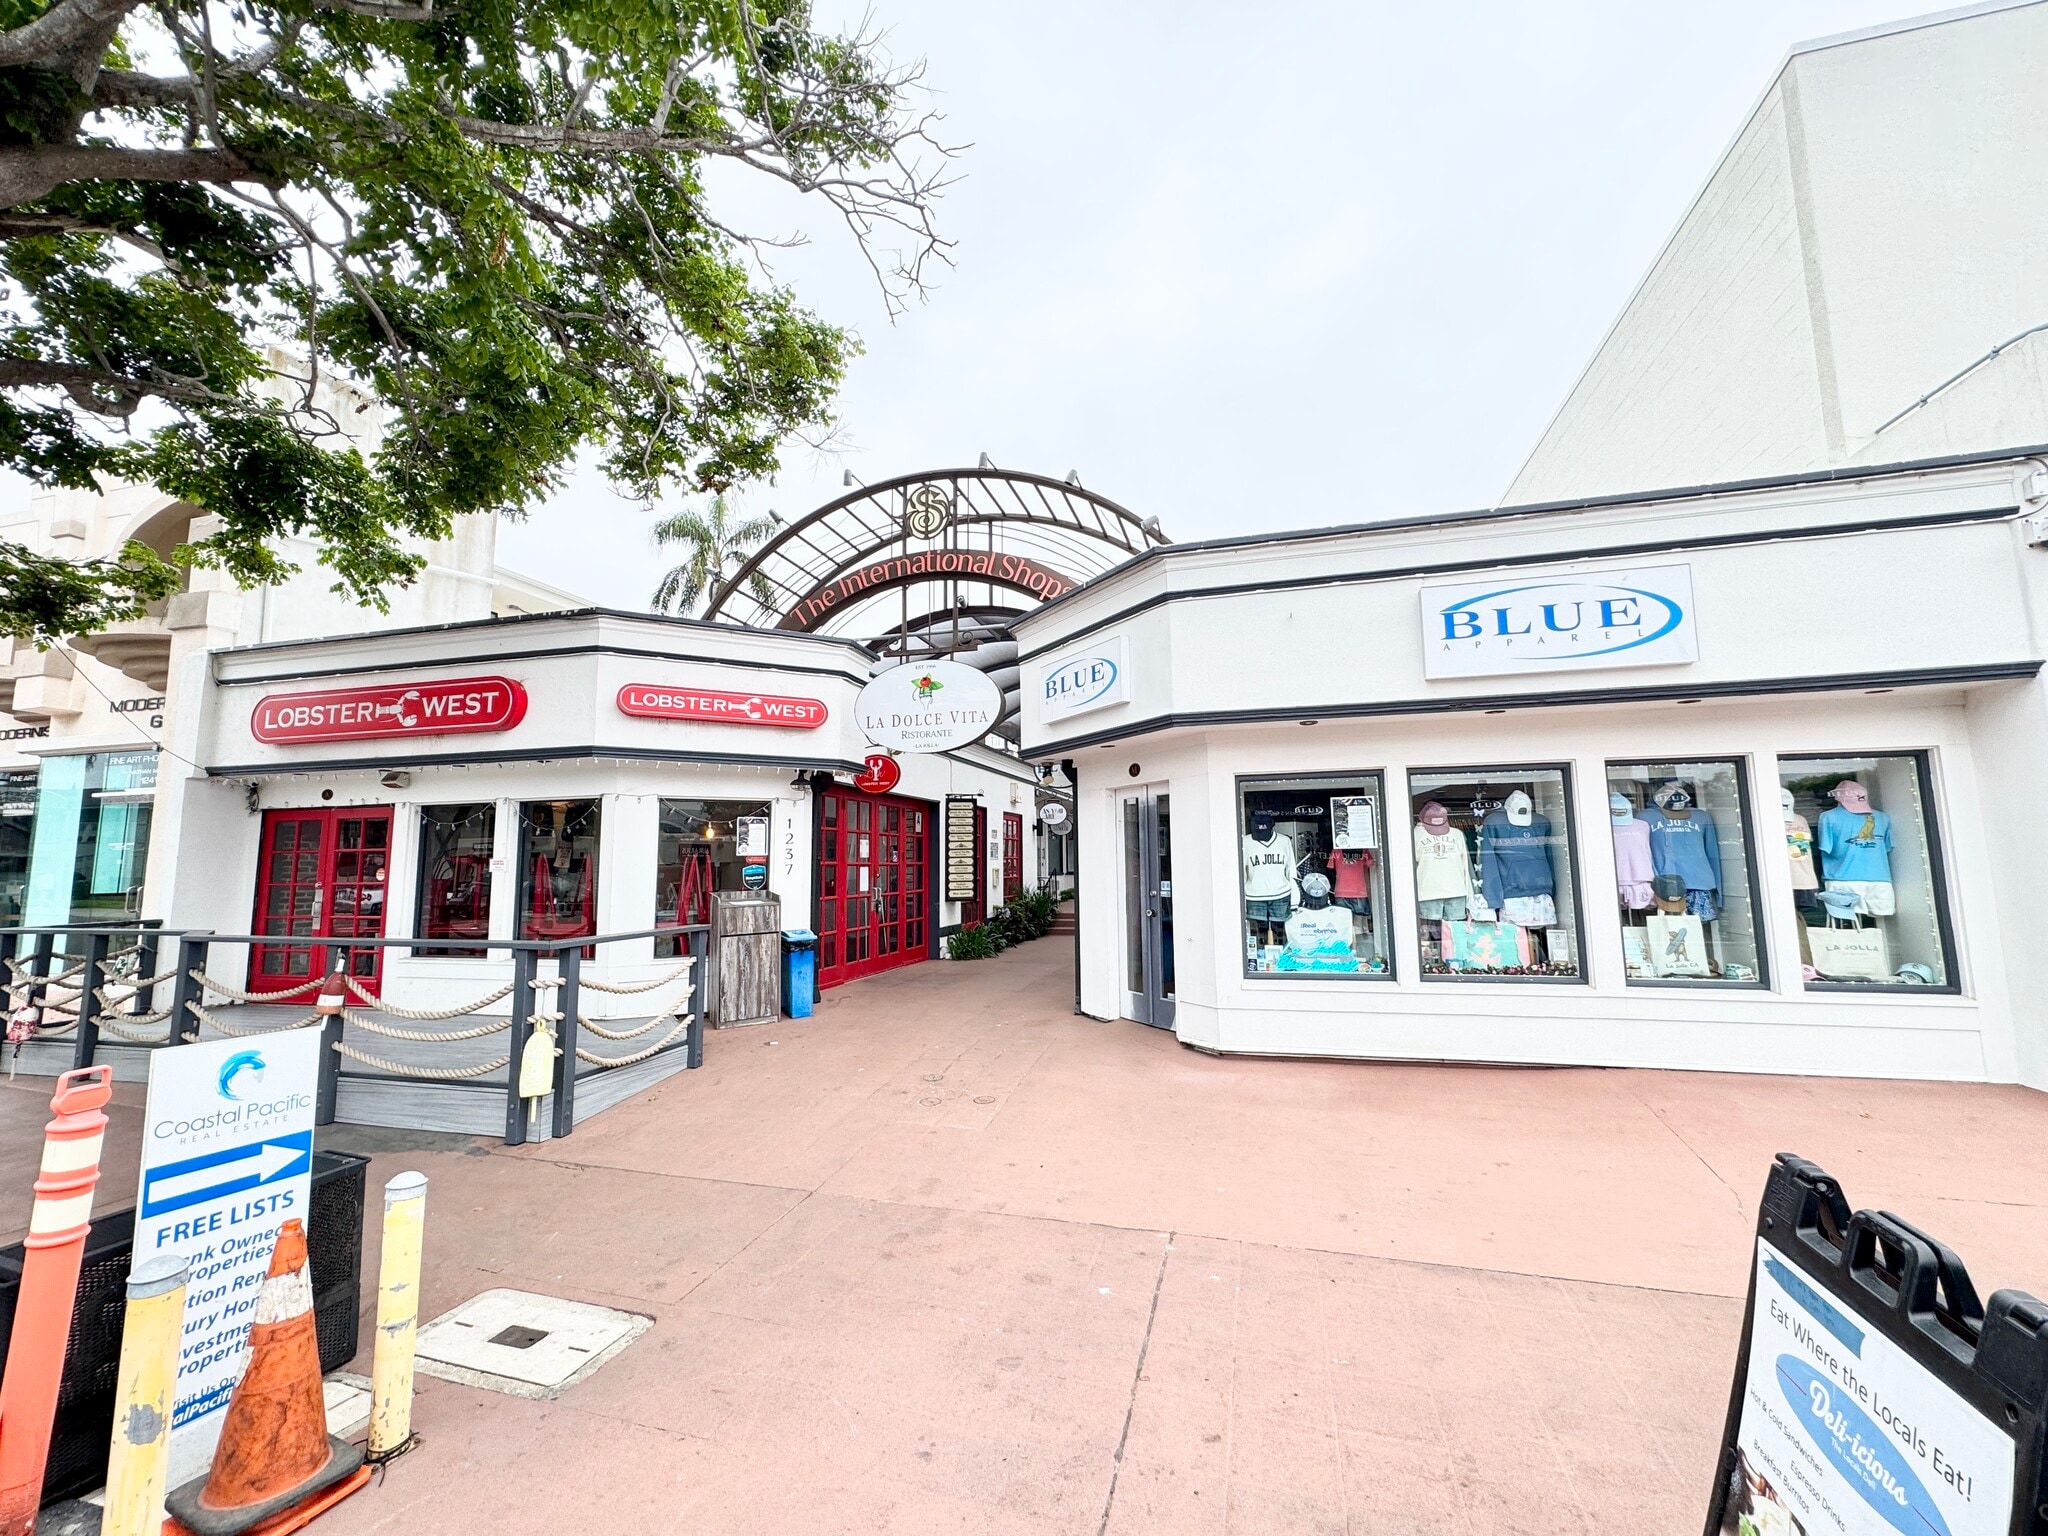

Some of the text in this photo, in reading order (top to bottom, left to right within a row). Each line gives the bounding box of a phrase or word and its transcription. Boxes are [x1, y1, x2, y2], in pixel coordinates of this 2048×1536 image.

[790, 589, 836, 626] The
[839, 550, 996, 598] International
[1440, 597, 1642, 640] BLUE
[1443, 629, 1644, 651] APPAREL
[1045, 662, 1105, 699] BLUE
[150, 715, 163, 728] G
[264, 691, 499, 729] LOBSTER WEST
[630, 692, 818, 720] LOBSTER WEST
[866, 710, 988, 729] LA DOLCE VITA
[901, 729, 953, 740] RISTORANTE
[1262, 853, 1285, 865] JOLL
[154, 1093, 311, 1139] Coastal Pacific
[179, 1115, 289, 1145] REAL ESTATE
[156, 1190, 295, 1248] FREE LISTS
[184, 1245, 217, 1266] nk
[179, 1321, 253, 1359] vestme
[182, 1311, 220, 1335] ury
[1770, 1298, 1974, 1503] Eat Where the Locals Eat!
[1750, 1388, 1824, 1477] Hot & Cold Sandwiches
[1809, 1379, 1909, 1506] Deli-icious
[1753, 1439, 1810, 1514] Breakfast Burritos
[1790, 1460, 1846, 1533] Espresso Drinks
